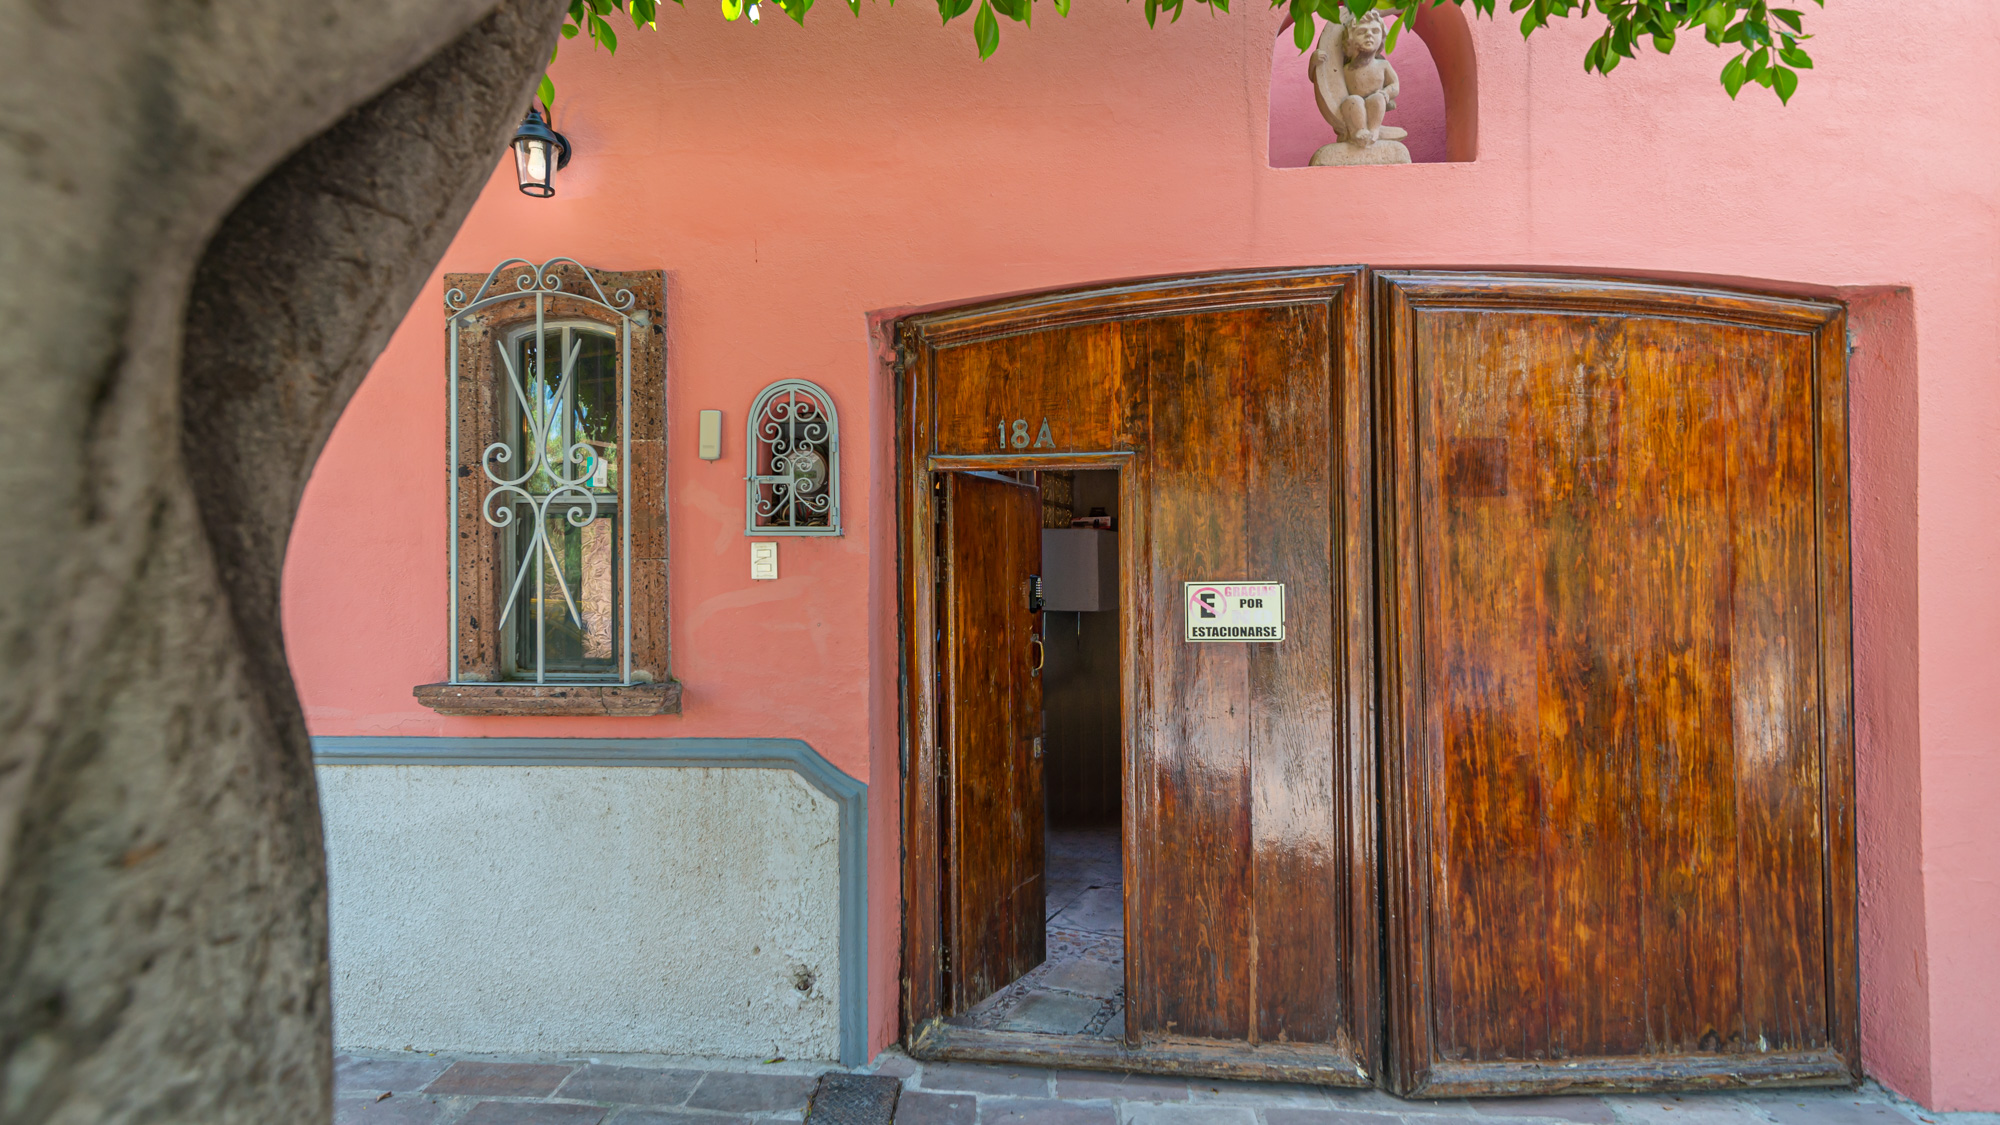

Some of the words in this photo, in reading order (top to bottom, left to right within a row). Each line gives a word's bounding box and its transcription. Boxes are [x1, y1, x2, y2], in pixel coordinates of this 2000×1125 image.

[998, 417, 1056, 449] 18A
[1224, 586, 1277, 597] GRACIAS
[1239, 598, 1263, 609] POR
[1192, 626, 1277, 637] ESTACIONARSE
